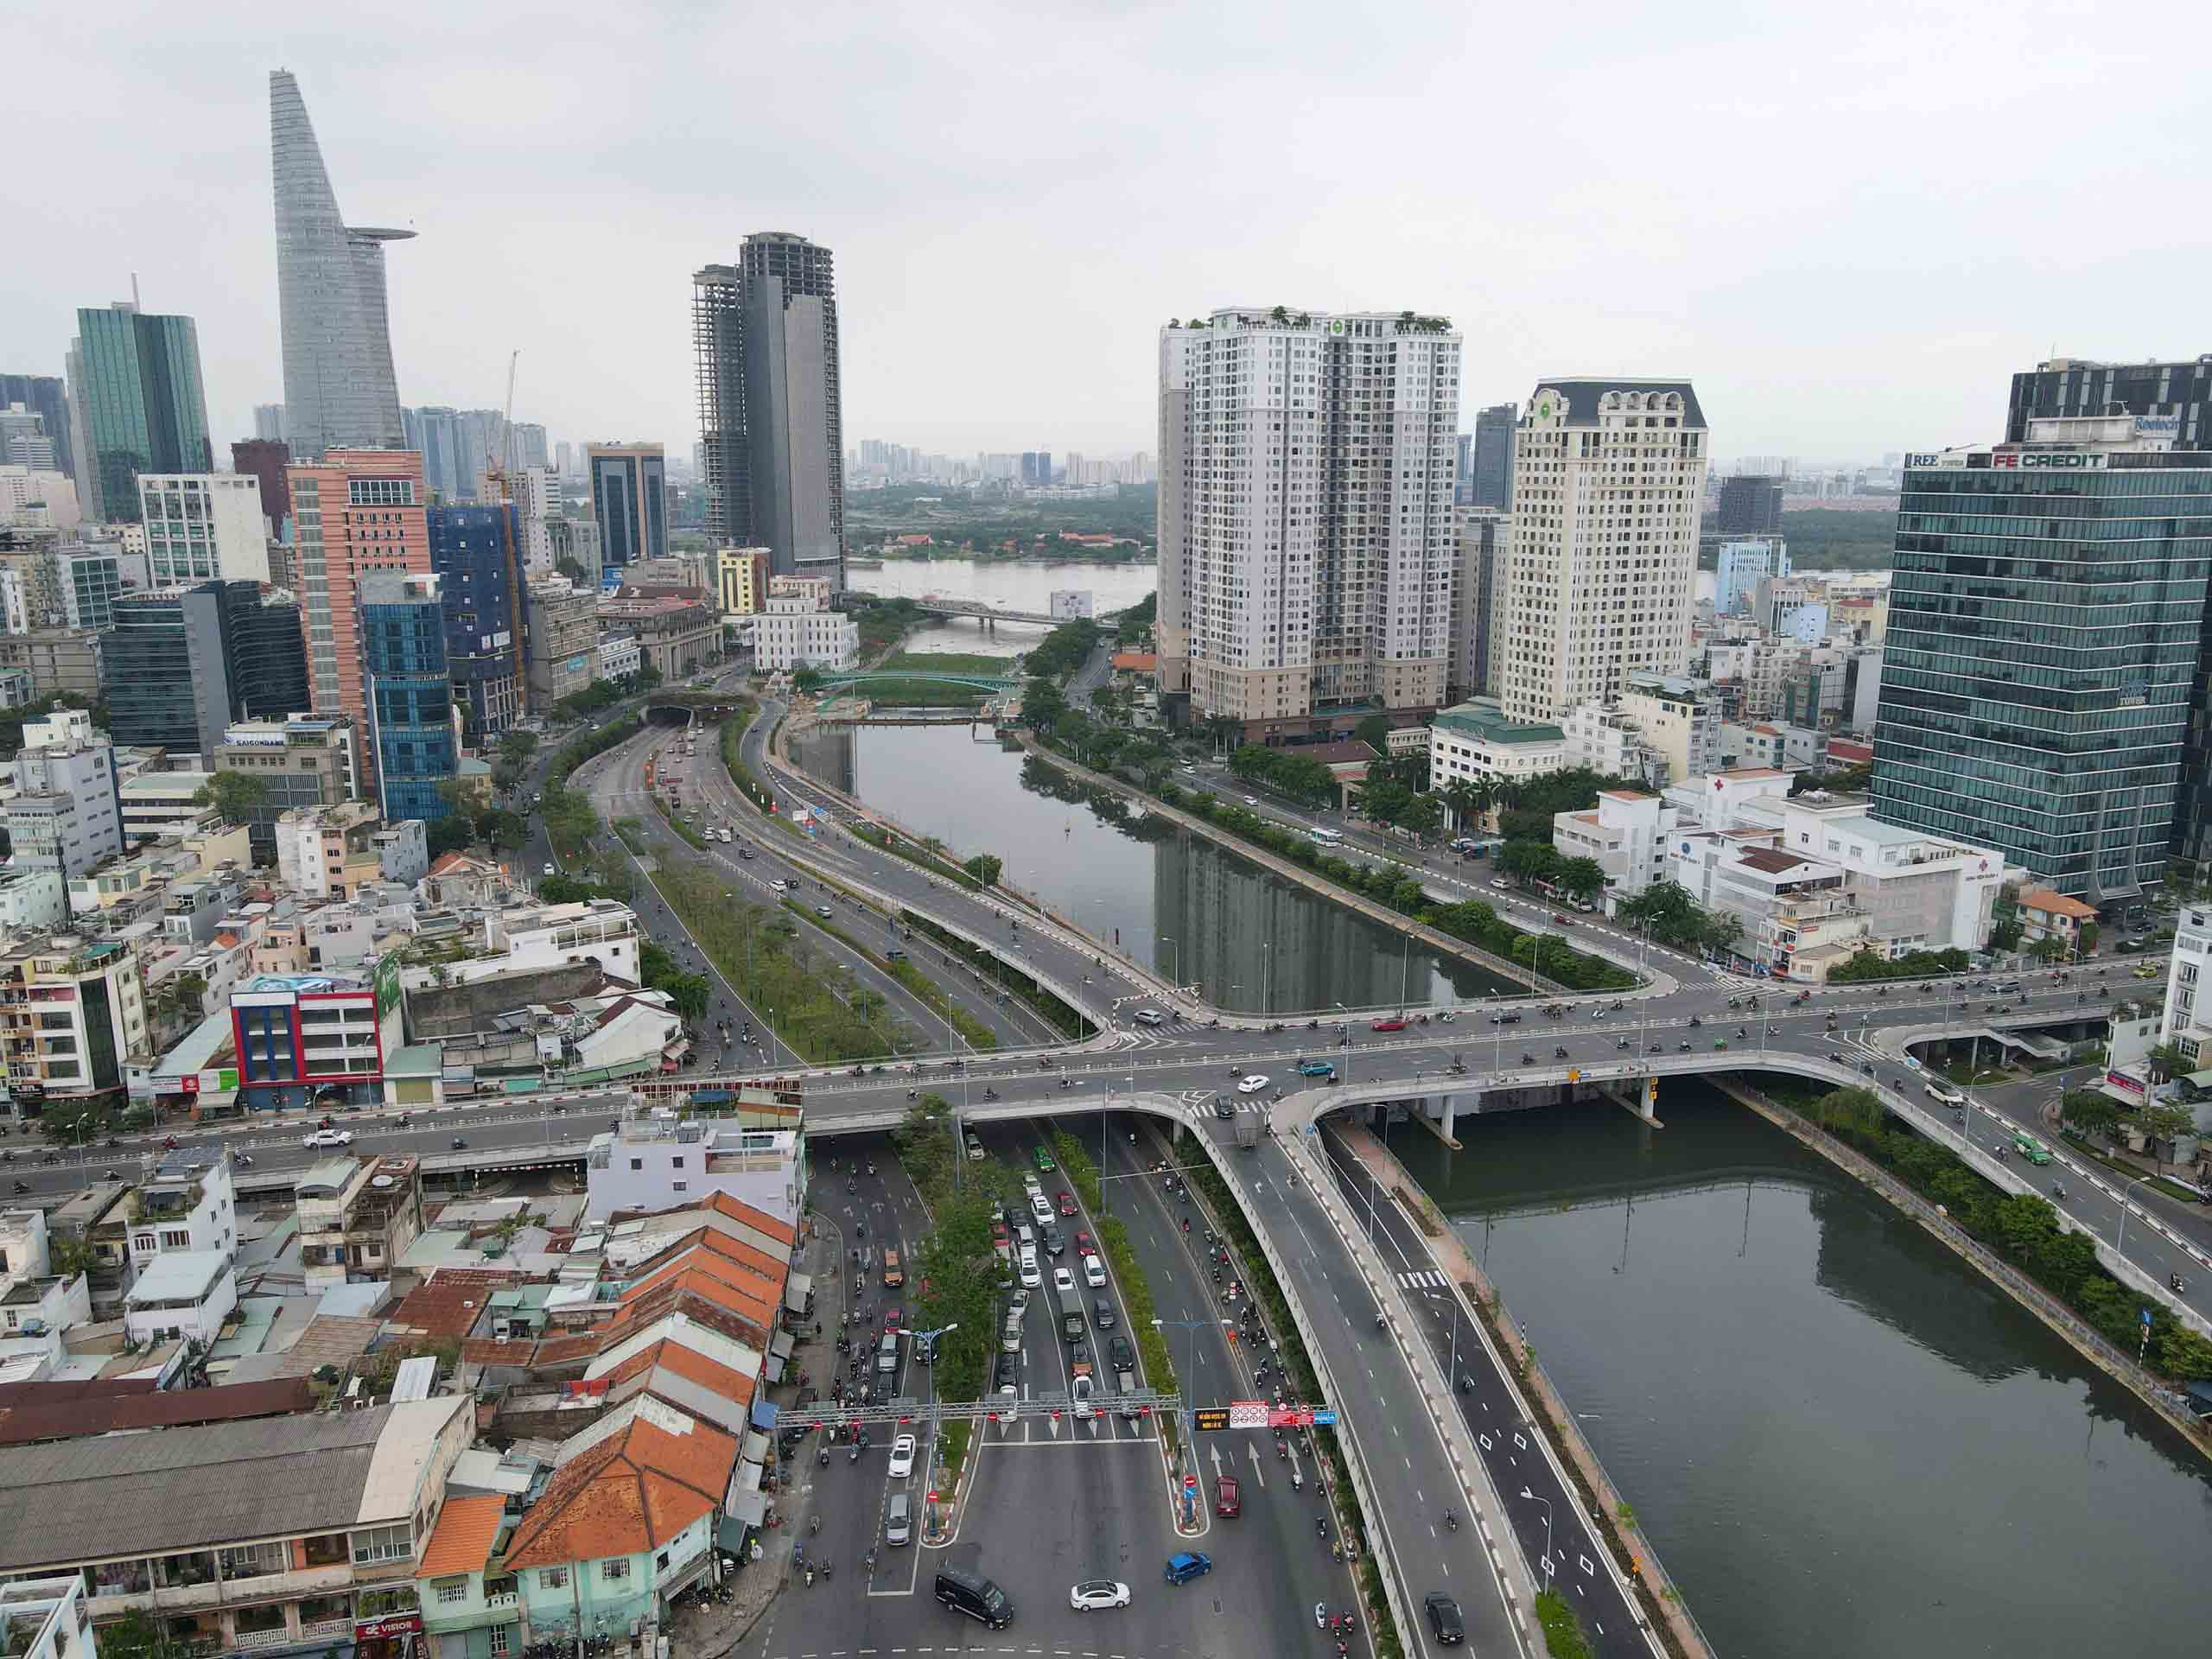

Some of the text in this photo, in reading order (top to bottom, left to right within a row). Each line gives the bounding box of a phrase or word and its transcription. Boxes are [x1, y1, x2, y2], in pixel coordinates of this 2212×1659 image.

[1913, 454, 1939, 467] REE
[1993, 454, 2104, 467] FE CREDIT
